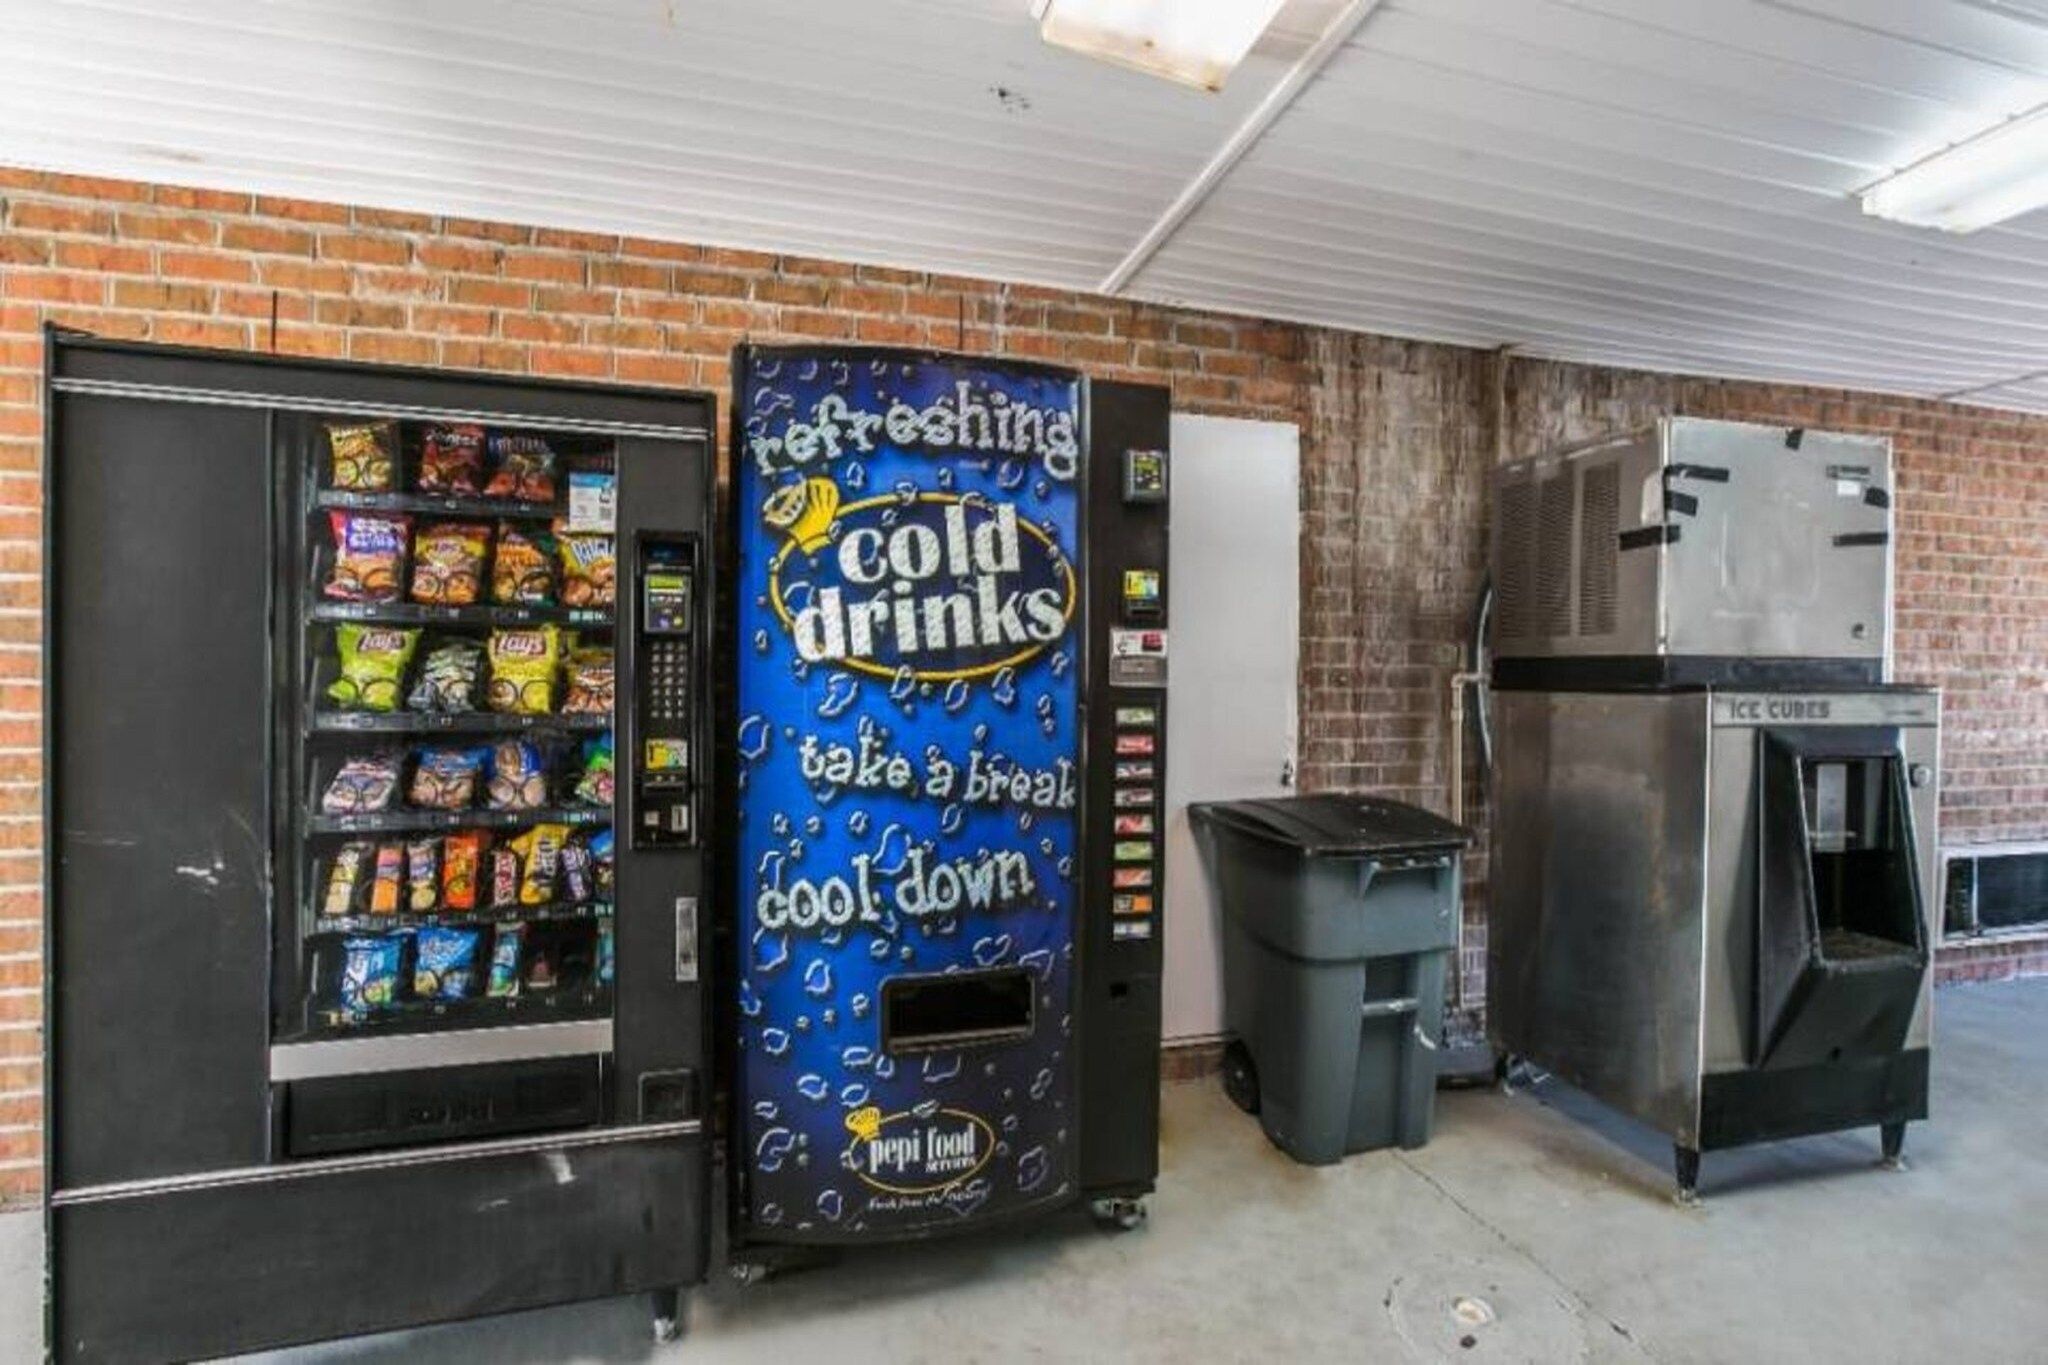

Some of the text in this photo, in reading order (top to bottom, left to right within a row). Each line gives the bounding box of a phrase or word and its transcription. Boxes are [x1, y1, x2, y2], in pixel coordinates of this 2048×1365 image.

[751, 381, 1078, 480] refreshing
[837, 503, 1021, 583] cold
[794, 573, 1066, 662] drinks
[1730, 700, 1830, 719] ICE CUBES
[801, 730, 1077, 809] take a break
[757, 847, 1035, 928] cool down
[869, 1122, 976, 1174] pepi food
